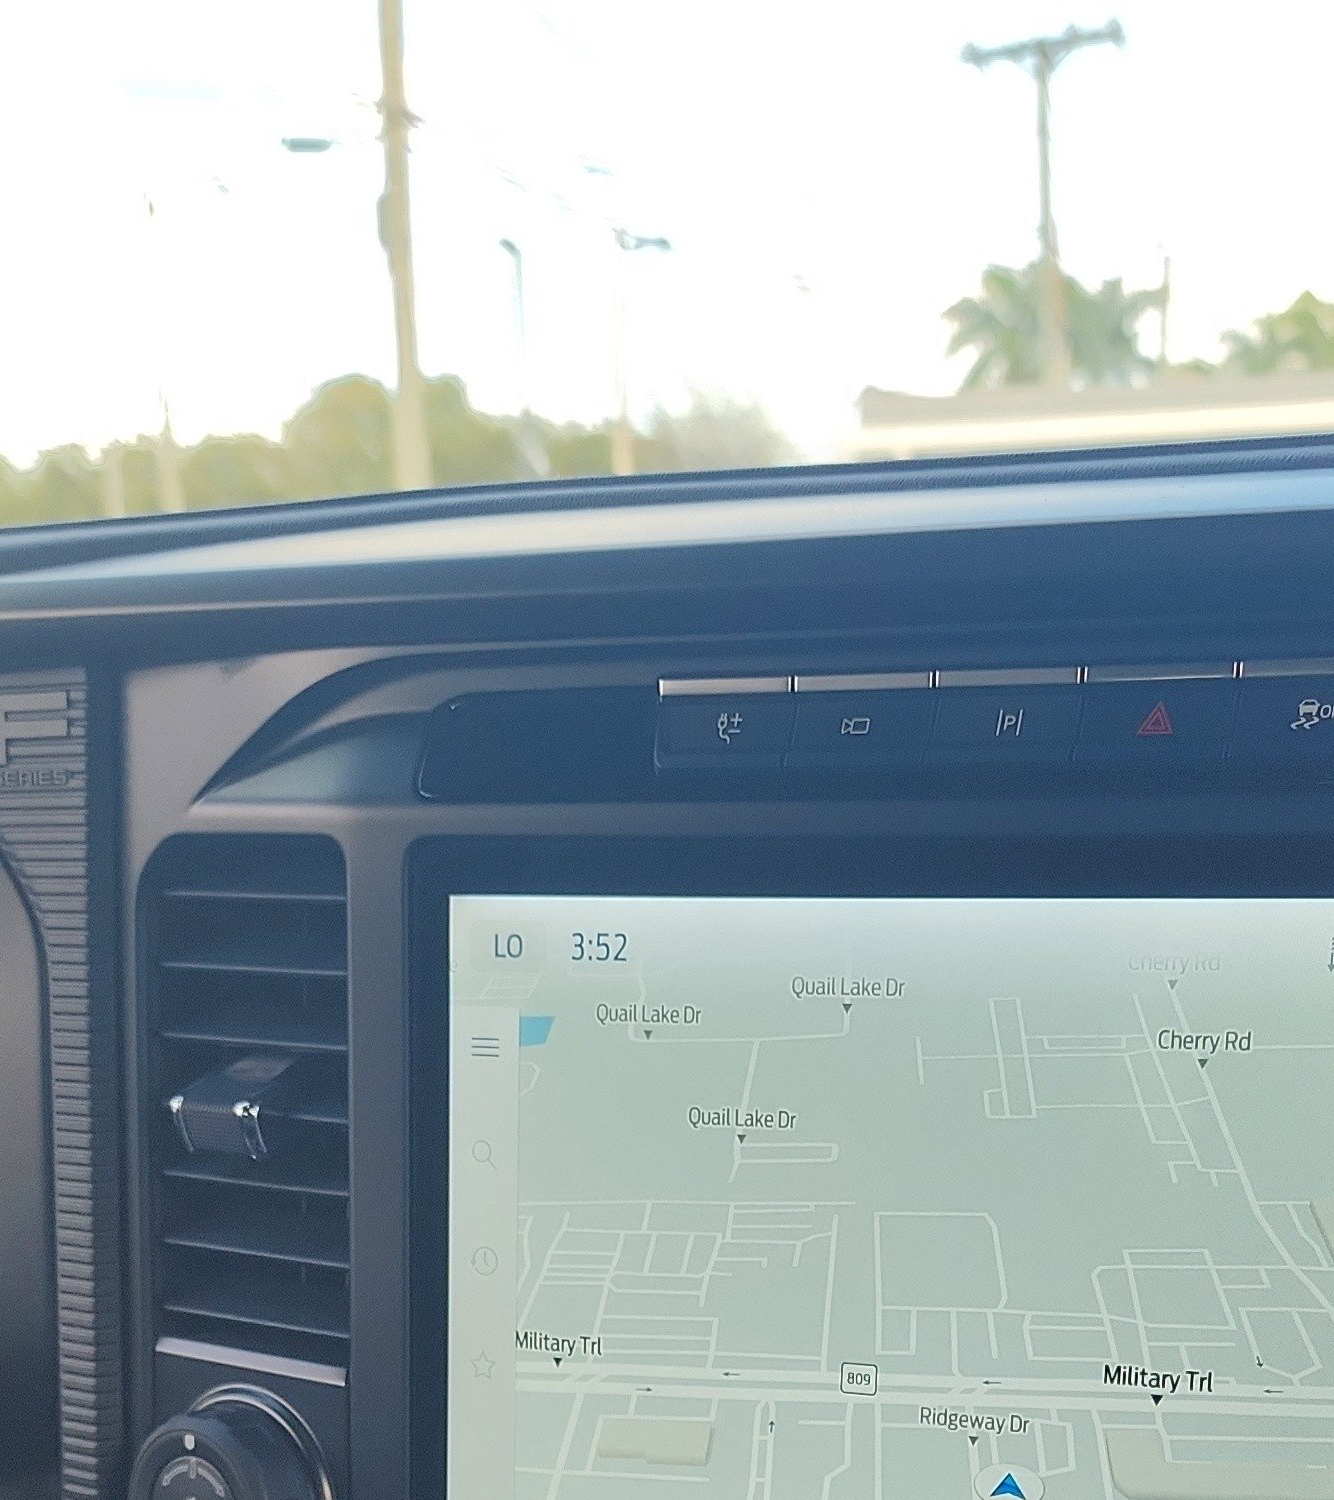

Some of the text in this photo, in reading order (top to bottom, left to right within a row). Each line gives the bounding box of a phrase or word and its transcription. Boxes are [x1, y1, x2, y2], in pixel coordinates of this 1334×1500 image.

[494, 933, 524, 959] LO
[570, 932, 628, 963] 3:52
[790, 976, 906, 999] Quail Lake Dr
[595, 1003, 702, 1026] Quail Lake Dr
[1157, 1029, 1252, 1055] Cherry Rd
[687, 1107, 797, 1130] Quail Lake Dr
[515, 1330, 603, 1357] Military Trl
[846, 1370, 872, 1388] 809
[1103, 1364, 1214, 1396] Military Trl
[919, 1406, 1030, 1437] Ridgeway Dr
